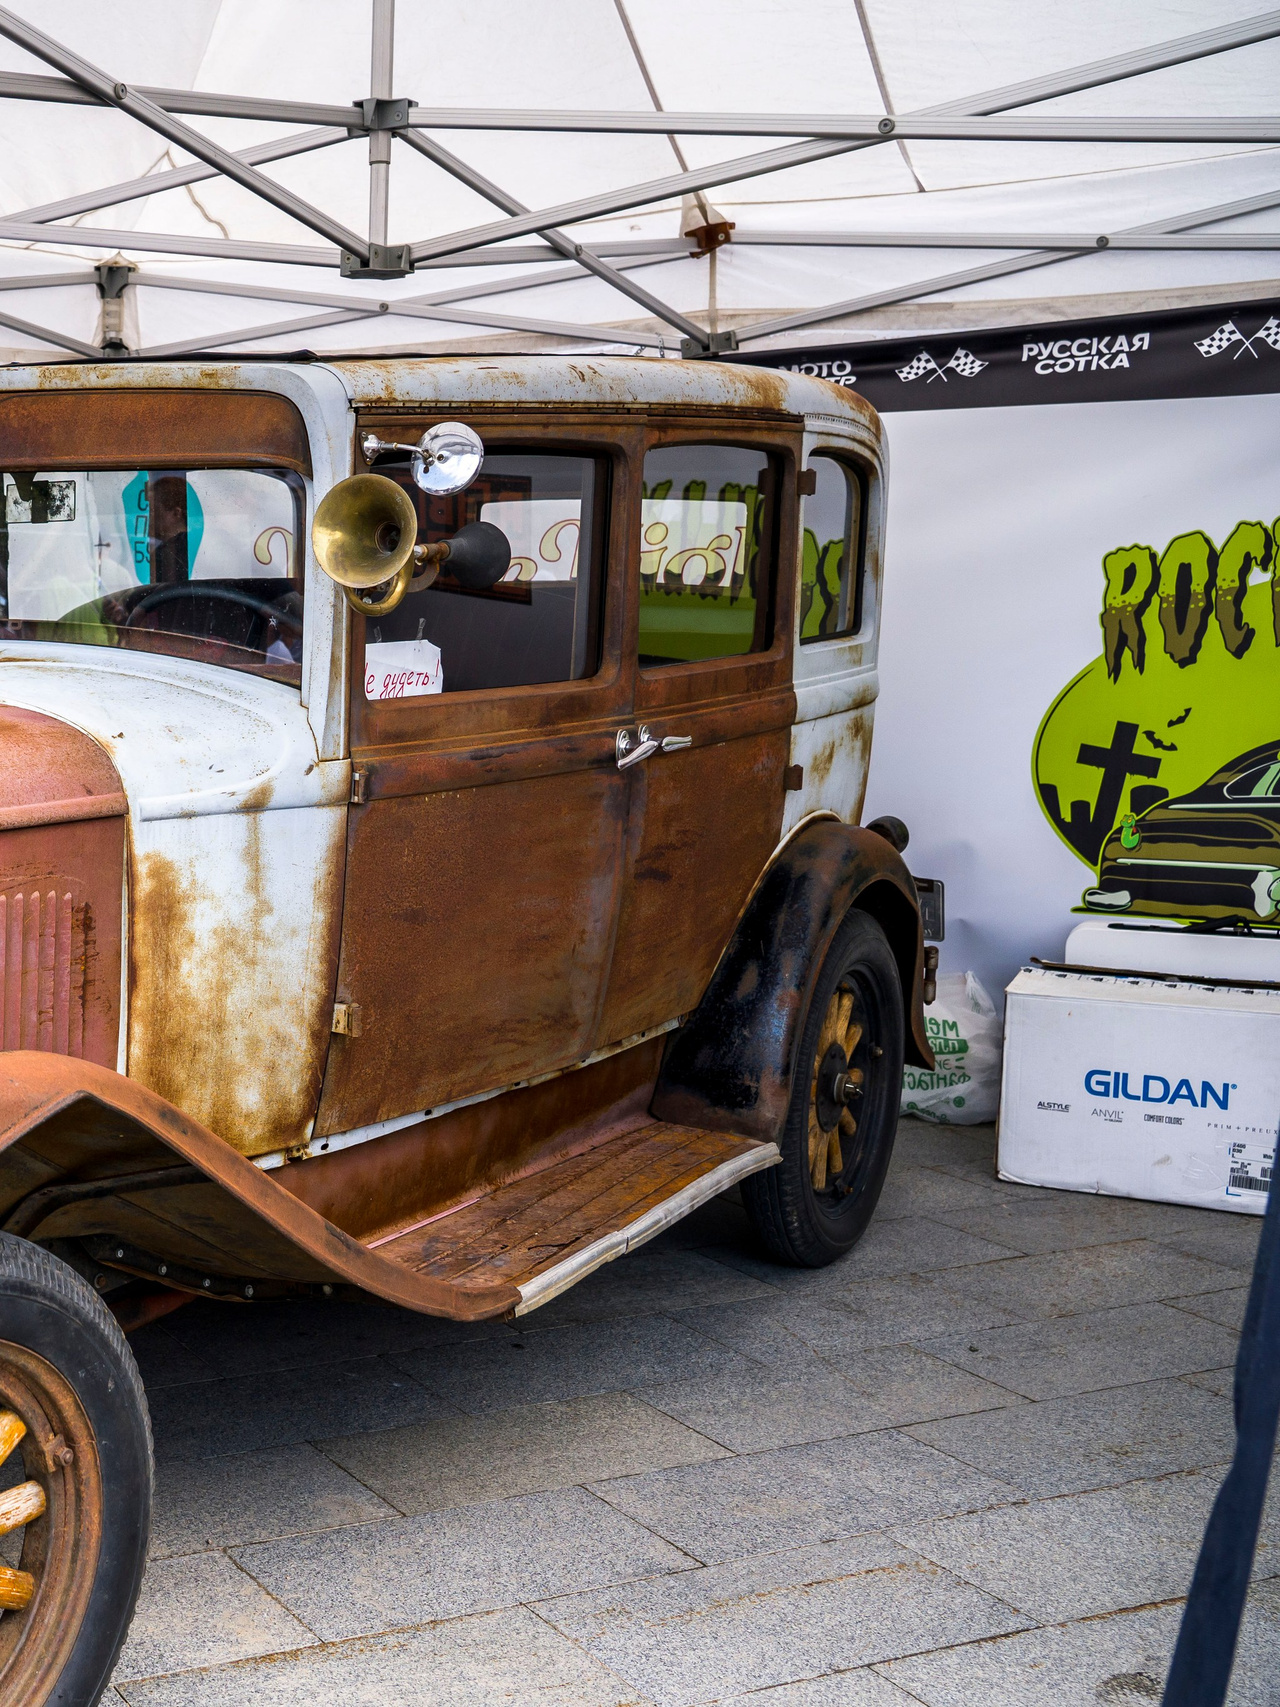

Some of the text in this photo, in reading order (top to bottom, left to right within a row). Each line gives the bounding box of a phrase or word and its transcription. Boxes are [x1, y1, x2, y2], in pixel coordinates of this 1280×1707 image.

[1021, 332, 1150, 362] РУССКАЯ
[1034, 352, 1130, 375] СОТКА
[1100, 516, 1280, 685] ROC
[1037, 1101, 1070, 1111] ALSTYLE
[1143, 1113, 1165, 1124] COMFORT
